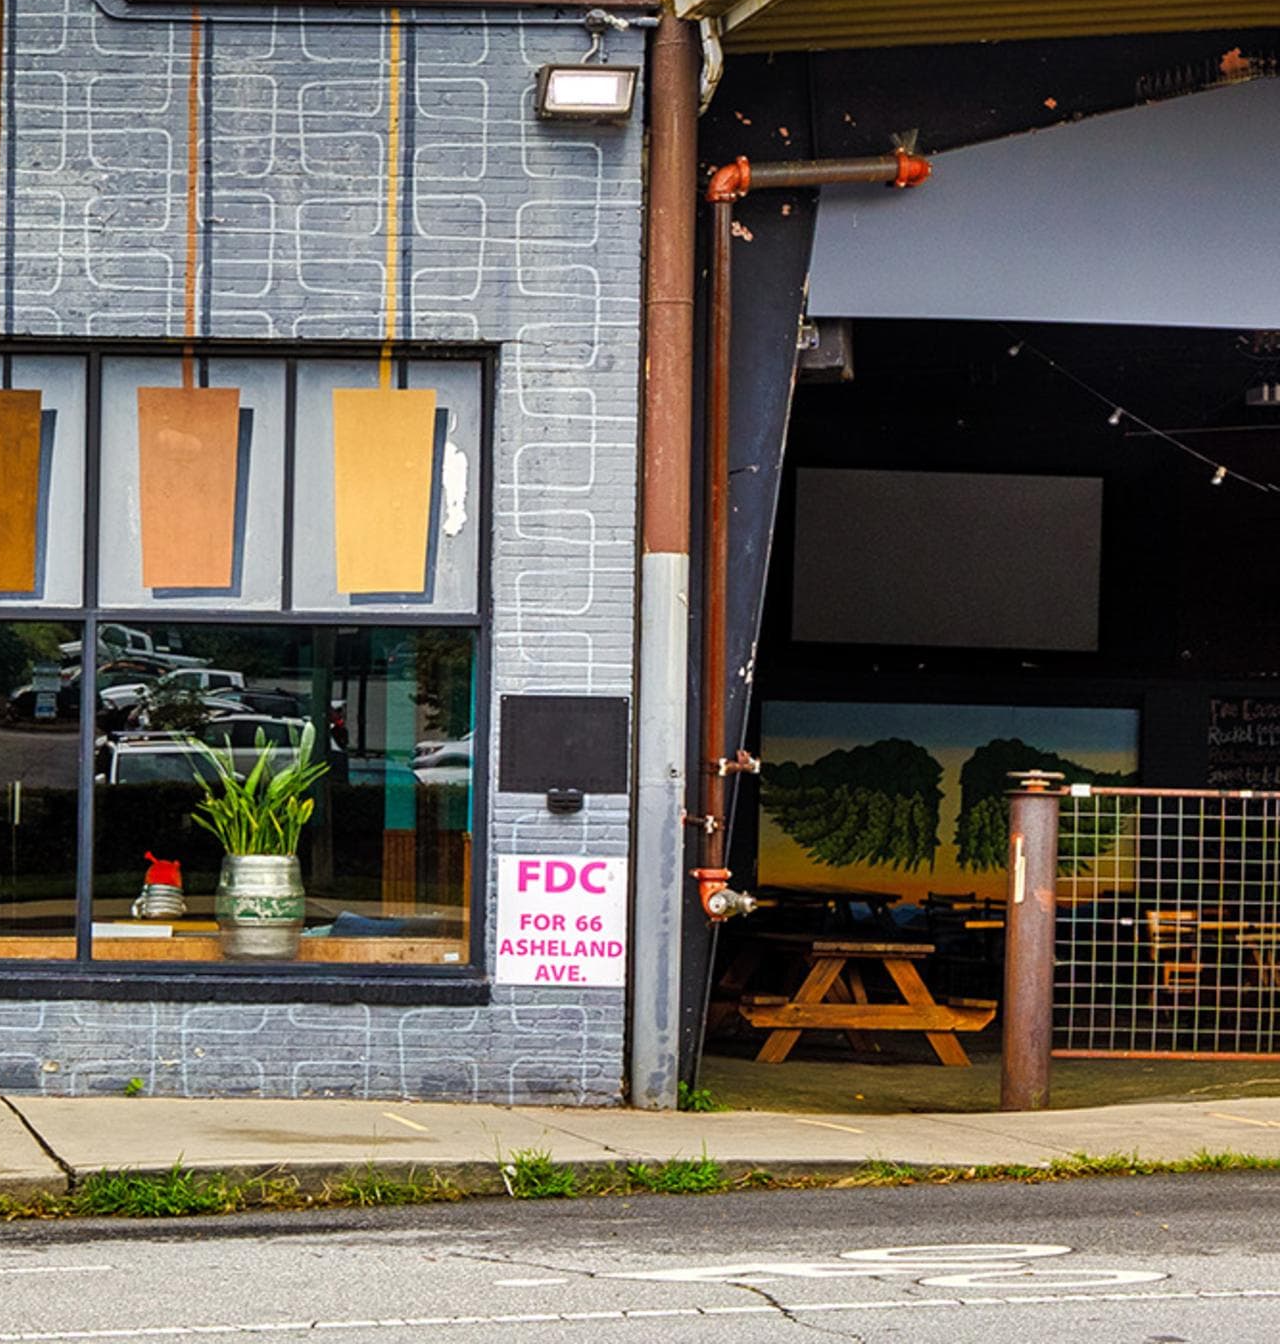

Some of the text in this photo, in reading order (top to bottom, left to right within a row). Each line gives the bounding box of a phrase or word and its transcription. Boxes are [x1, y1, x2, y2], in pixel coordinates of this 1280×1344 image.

[518, 861, 607, 894] FDC
[520, 913, 603, 932] FOR 66
[499, 938, 623, 957] ASHELAND
[535, 964, 587, 982] AVE.
